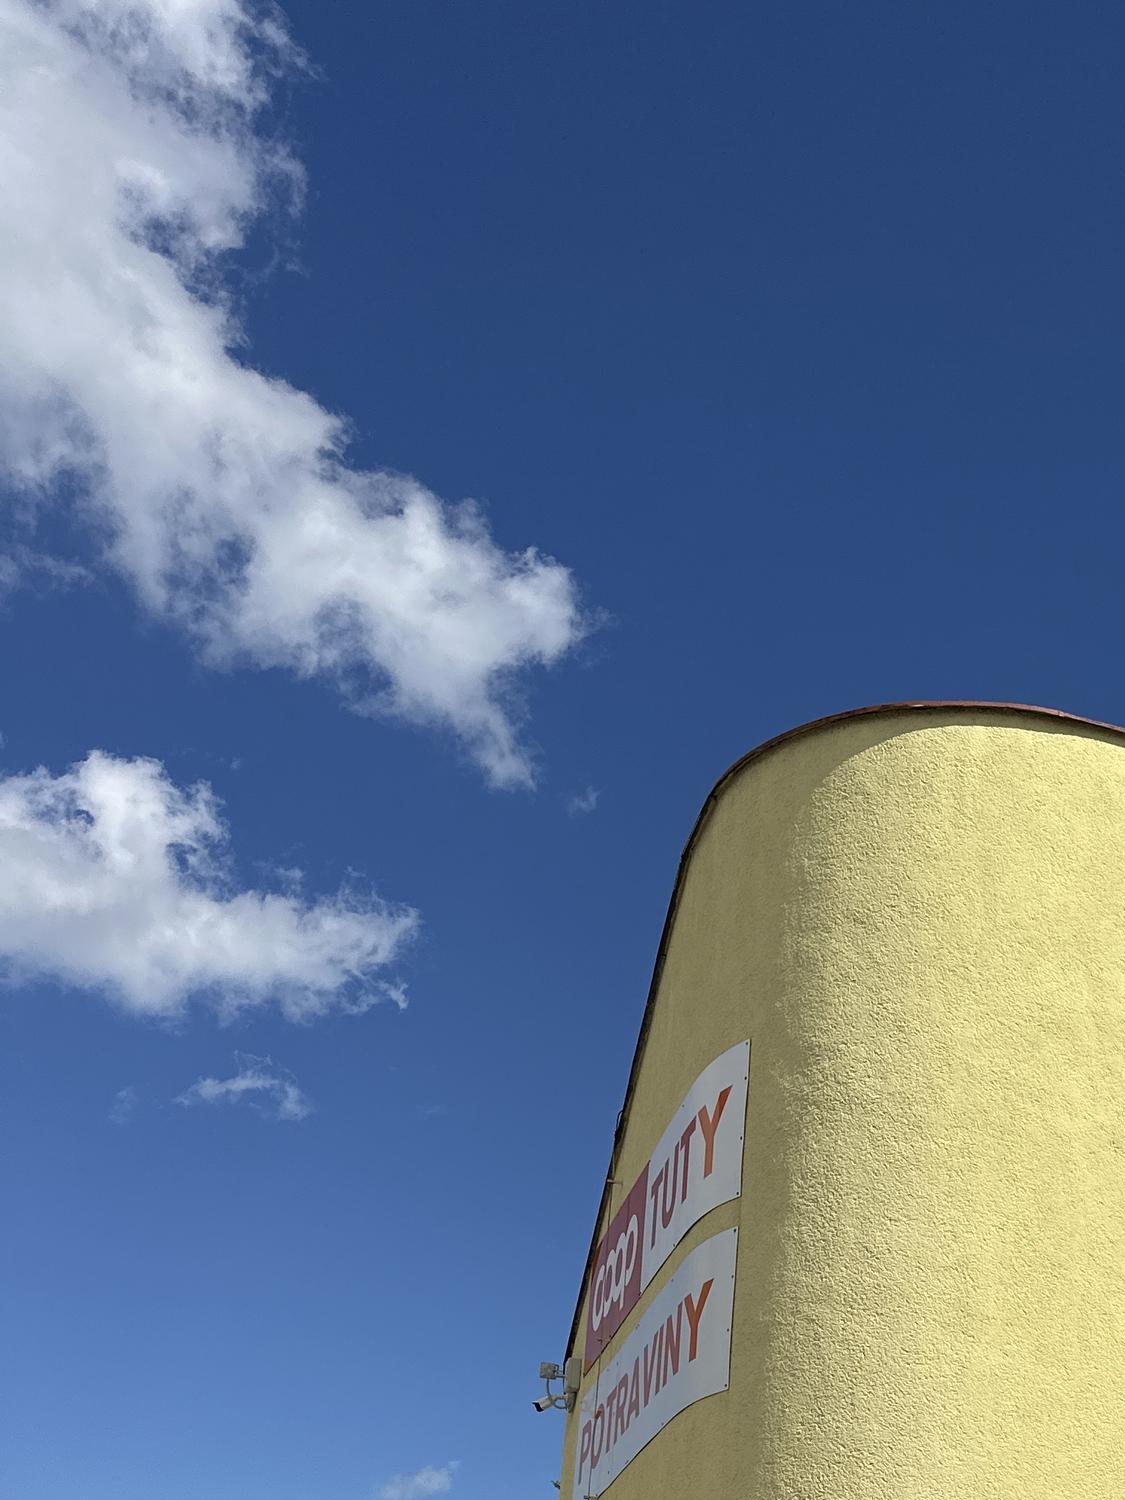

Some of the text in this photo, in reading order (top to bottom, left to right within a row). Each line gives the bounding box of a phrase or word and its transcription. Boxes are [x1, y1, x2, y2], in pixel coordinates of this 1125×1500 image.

[592, 1085, 733, 1332] coop TUTY
[577, 1278, 714, 1486] POTRAVINY
